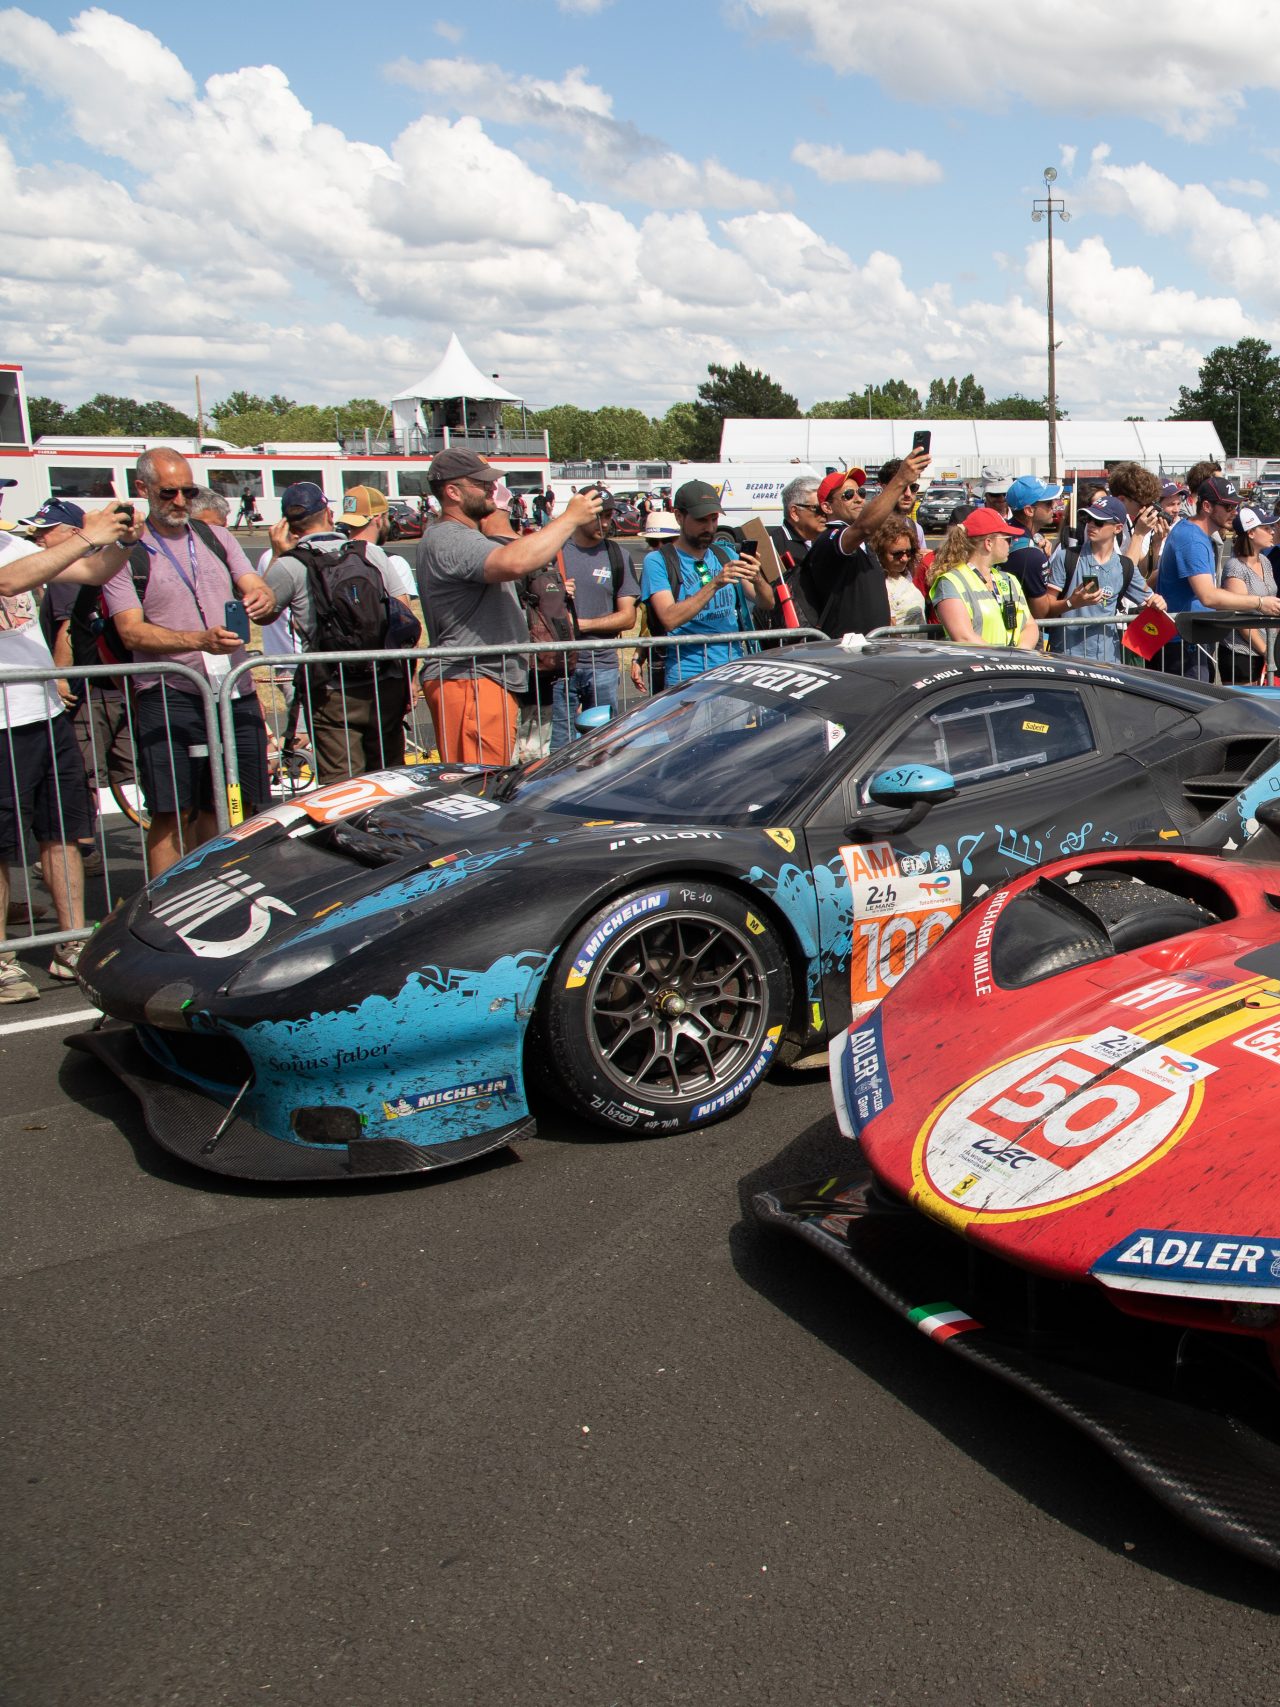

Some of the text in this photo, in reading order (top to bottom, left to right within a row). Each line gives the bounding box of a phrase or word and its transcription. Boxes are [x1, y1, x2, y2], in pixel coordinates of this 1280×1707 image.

[775, 483, 785, 491] TP
[934, 669, 963, 682] HULL
[996, 663, 1056, 673] HARYANTO
[632, 832, 724, 844] PILOTI
[852, 847, 896, 882] AM
[866, 884, 897, 905] 24h
[874, 902, 895, 910] MANS
[586, 894, 662, 957] MICHELIN
[974, 891, 1010, 998] RICHARD MILLE
[1109, 979, 1204, 1011] HY
[269, 1041, 392, 1073] Sonus faber
[851, 1027, 880, 1083] ADLER
[417, 1078, 508, 1108] MICHELIN
[697, 1056, 766, 1117] MICHELIN
[872, 1088, 884, 1112] PELZER
[858, 1095, 869, 1119] GROUP
[987, 1060, 1142, 1151] 50
[971, 1139, 1037, 1169] WEC
[1117, 1236, 1266, 1273] ADLER
